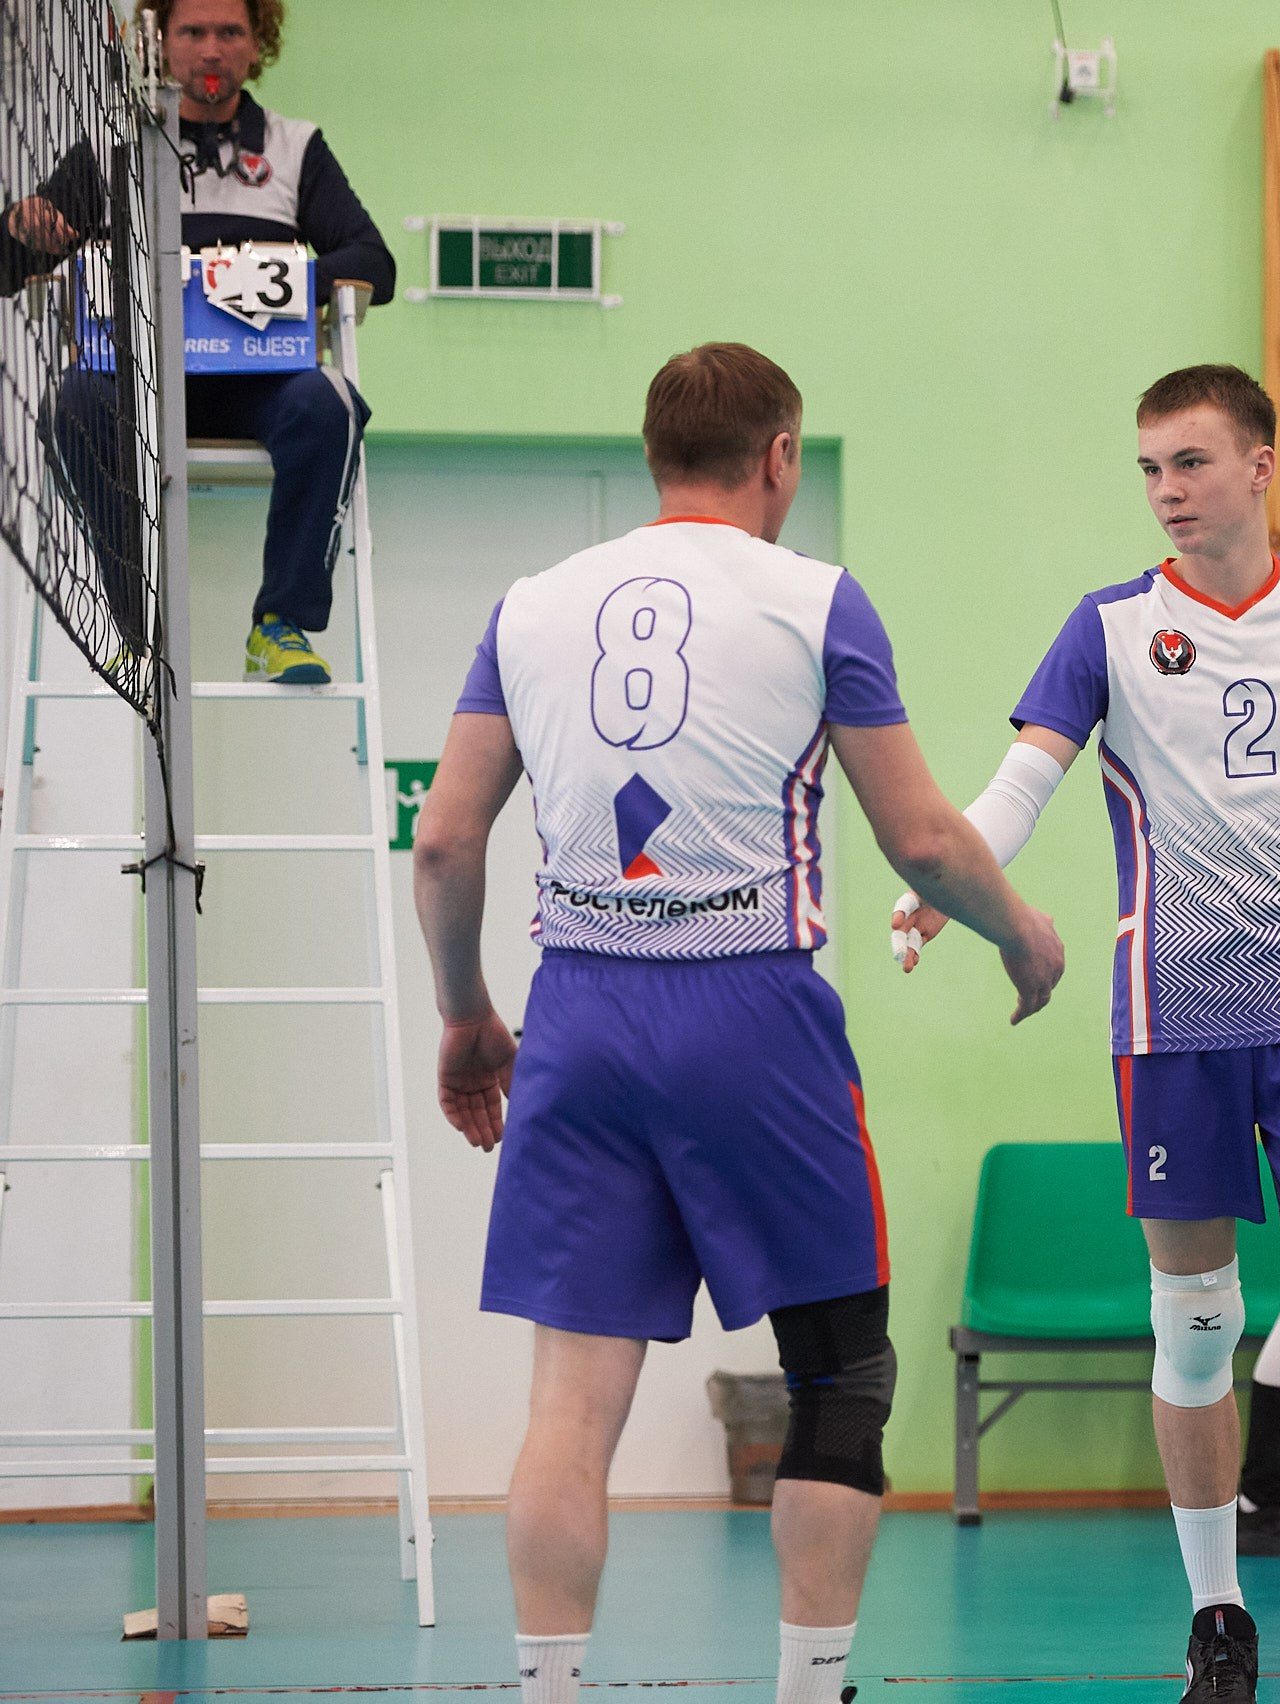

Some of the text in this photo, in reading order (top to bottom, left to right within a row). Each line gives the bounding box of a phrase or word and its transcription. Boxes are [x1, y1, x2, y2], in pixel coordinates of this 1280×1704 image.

[256, 258, 293, 308] 3
[494, 263, 541, 284] EXIT
[184, 338, 231, 353] RRES
[243, 336, 310, 357] GUEST
[590, 576, 692, 751] 8
[1222, 678, 1277, 779] 2
[1148, 1144, 1168, 1181] 2
